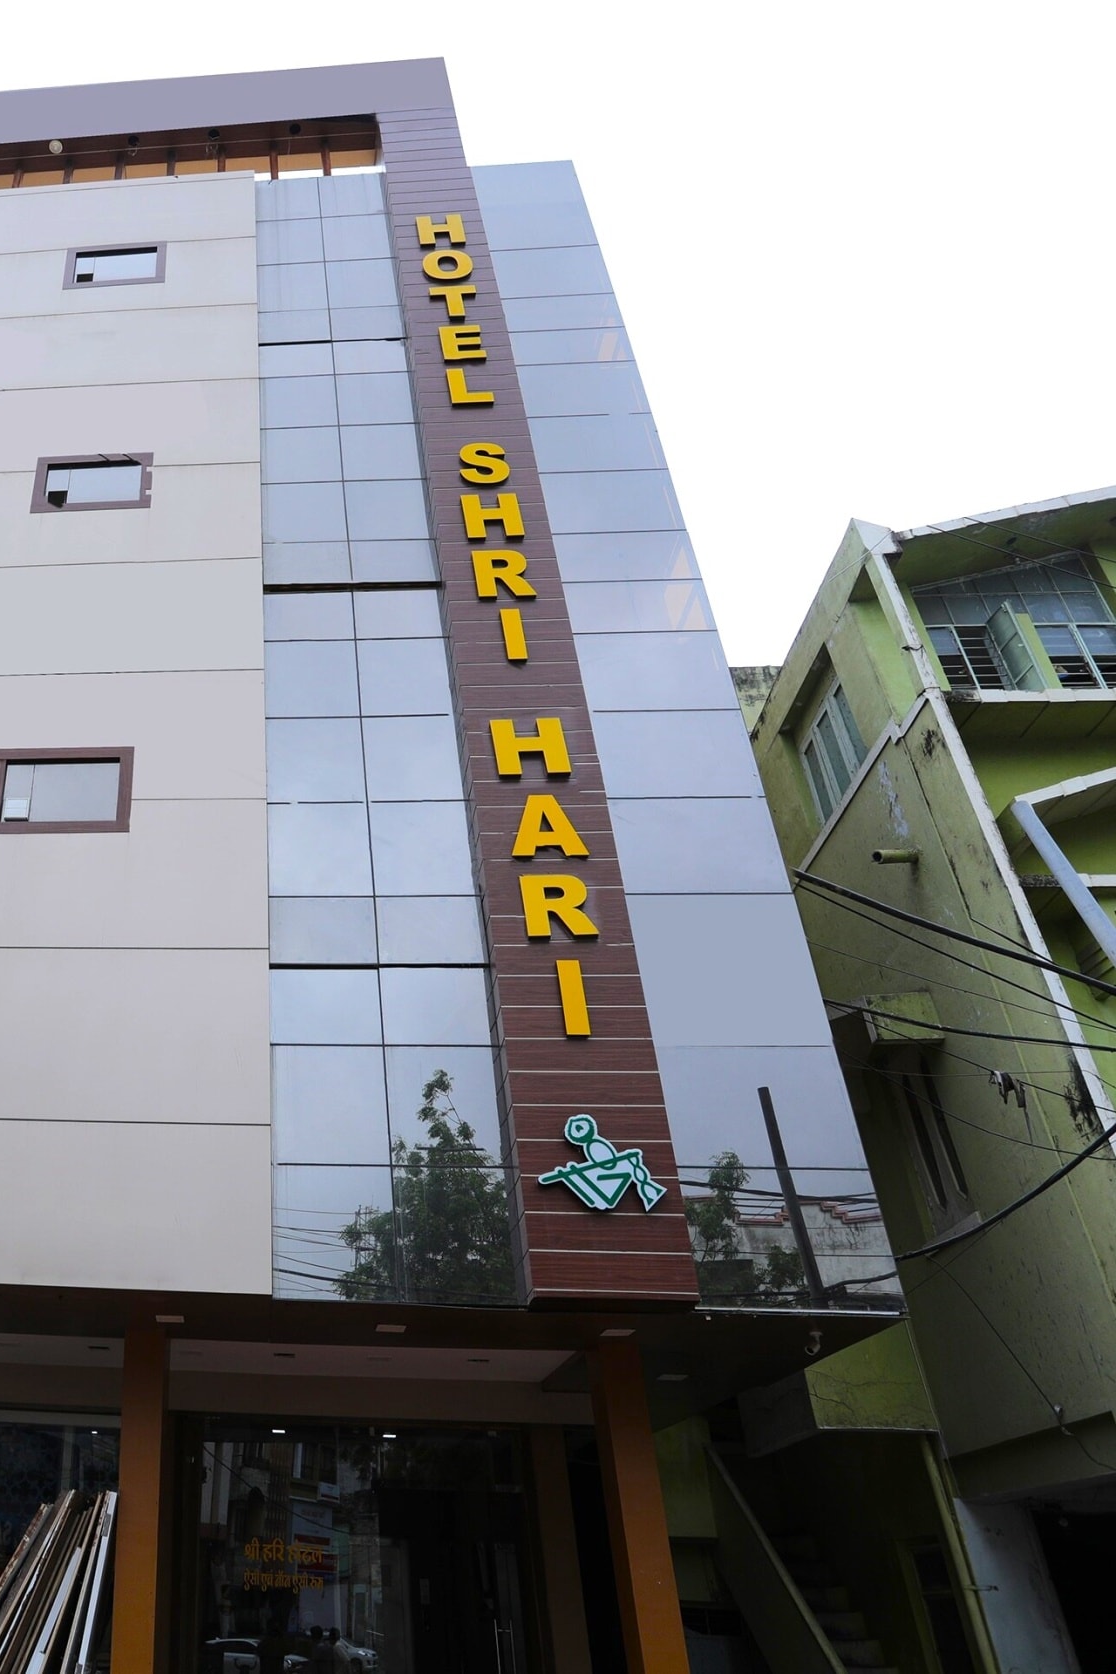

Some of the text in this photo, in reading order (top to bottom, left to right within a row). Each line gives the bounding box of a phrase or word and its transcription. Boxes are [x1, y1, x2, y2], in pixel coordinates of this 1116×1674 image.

[415, 214, 600, 1037] HOTEL SHRI HARI
